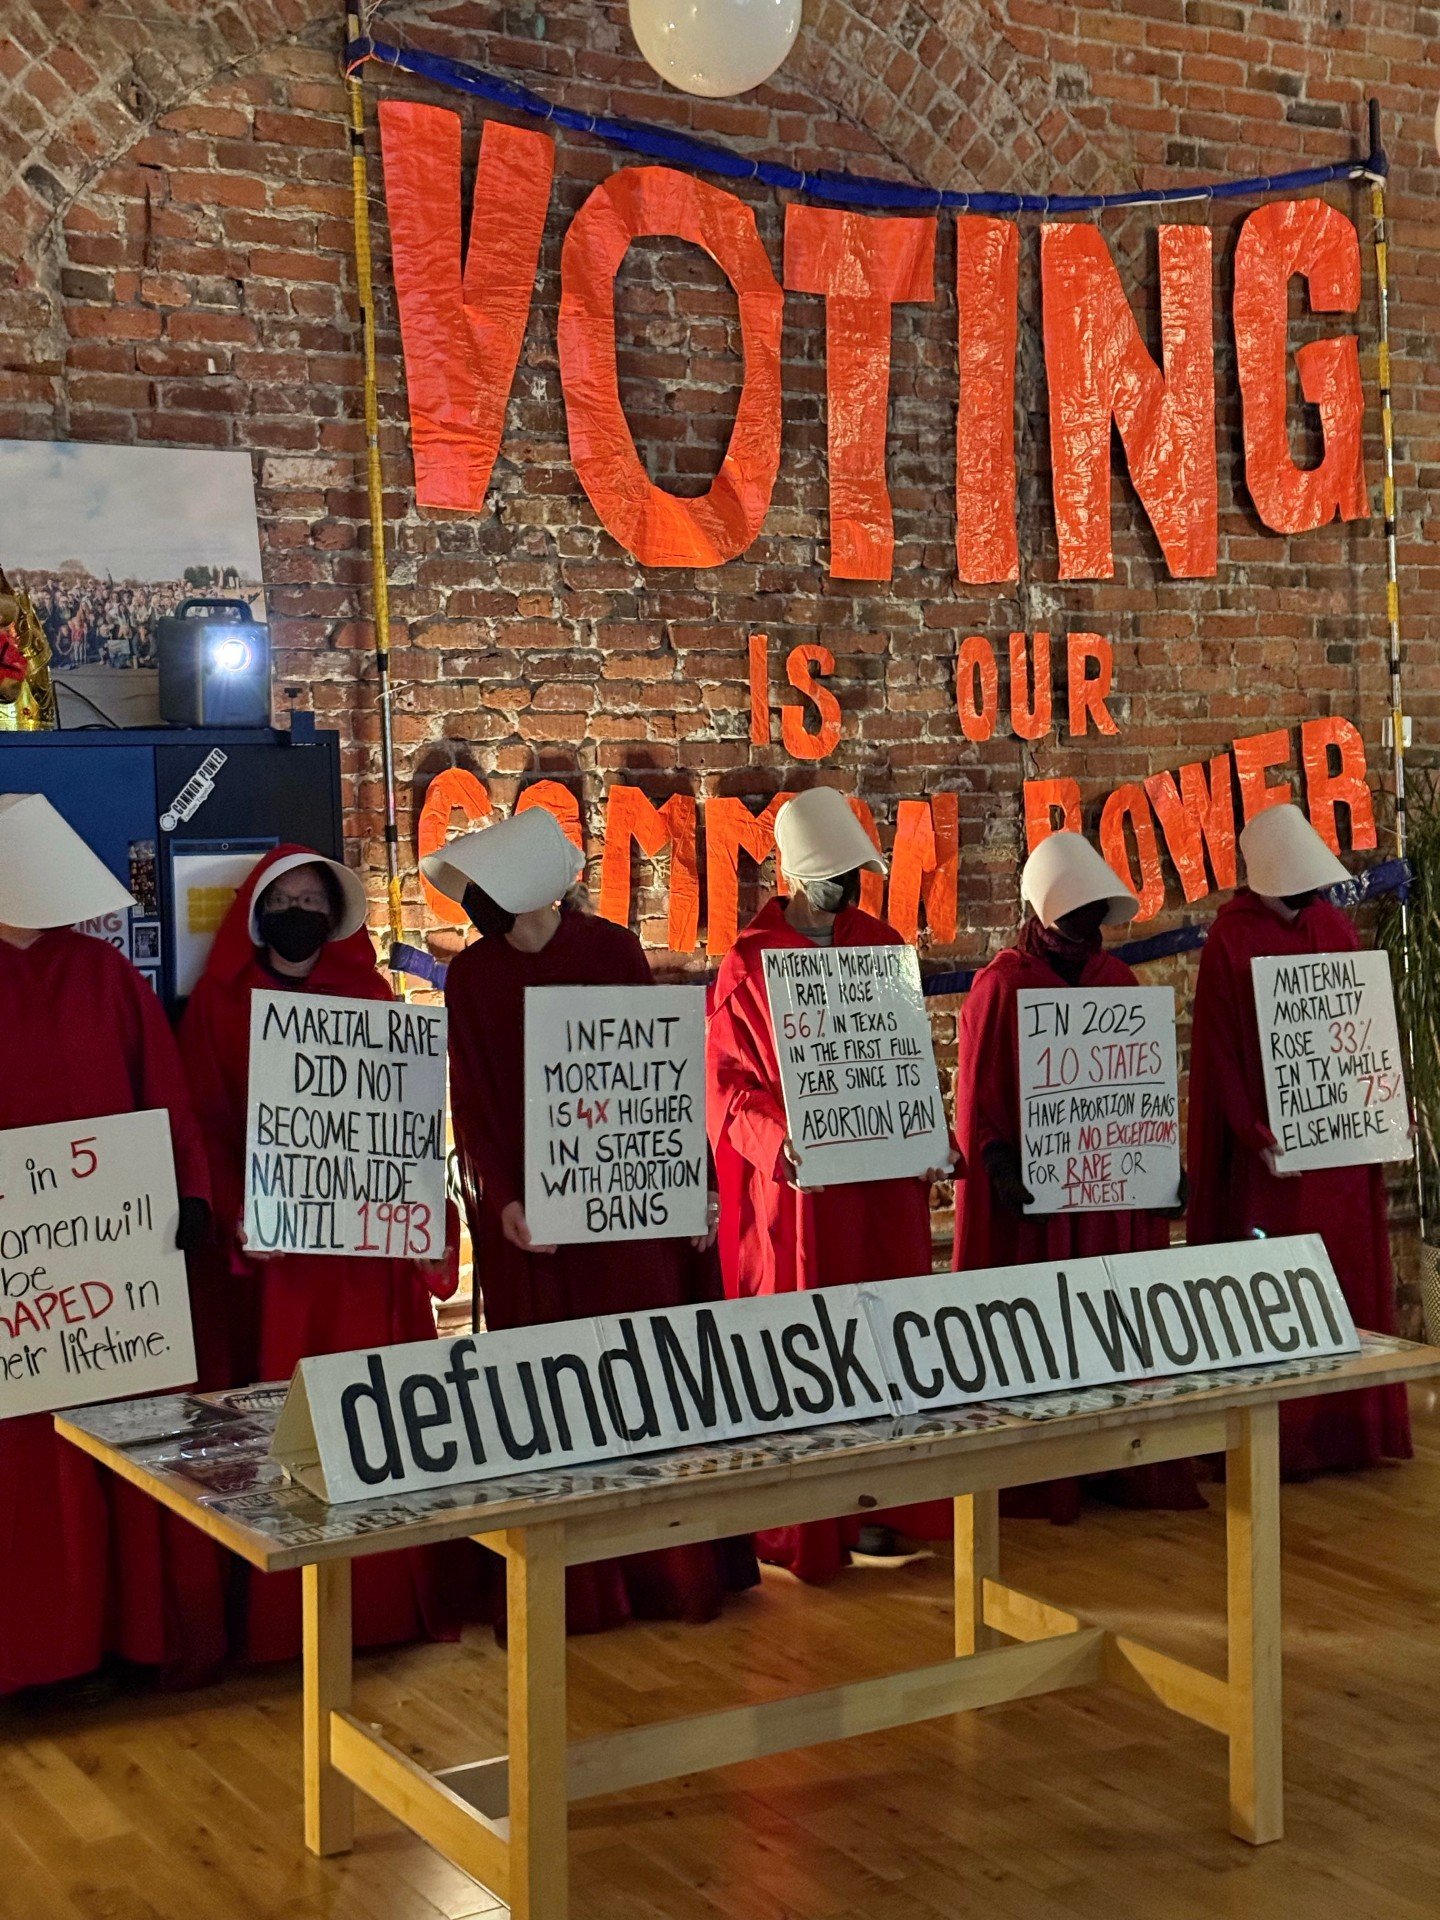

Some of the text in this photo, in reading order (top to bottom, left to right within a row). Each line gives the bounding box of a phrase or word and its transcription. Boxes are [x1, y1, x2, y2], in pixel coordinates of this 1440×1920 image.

[377, 100, 1370, 584] VOTING
[747, 632, 1120, 760] IS OUR
[172, 749, 226, 815] COMMON POWER
[767, 952, 833, 978] MATERNAL
[1273, 959, 1365, 997] MATERNAL
[796, 980, 873, 1006] RATE ROSE
[1273, 991, 1362, 1026] MORTALITY
[263, 1002, 441, 1056] MARITAL RAPE
[567, 1017, 680, 1052] INFANT
[783, 1009, 898, 1040] 56% IN TEXAS
[1024, 1001, 1146, 1037] IN 2025
[790, 1037, 922, 1064] IN THE FIRST FULL
[1271, 1018, 1372, 1060] ROSE 33%
[295, 1052, 408, 1102] DID NOT
[544, 1058, 688, 1093] MORTALITY
[797, 1063, 920, 1095] YEAR SINCE ITS
[1033, 1041, 1162, 1089] 10 STATES
[1275, 1050, 1392, 1089] IN TX WHILE
[549, 1094, 693, 1129] IS 4X HIGHER
[802, 1096, 935, 1141] ABORTION BAN
[1028, 1093, 1175, 1128] HAVE ABORTION BANS
[1280, 1083, 1348, 1117] FALLING
[258, 1102, 446, 1160] BECOME ILLEGAL
[550, 1129, 683, 1166] IN STATES
[1025, 1120, 1177, 1158] WITH NO EXCEPTIONS
[1282, 1110, 1389, 1152] ELSEWHERE
[25, 1136, 98, 1194] in 5
[252, 1152, 418, 1204] NATIONWIDE
[541, 1157, 701, 1197] WITH ABORTION
[1028, 1151, 1147, 1185] FOR RAPE OR
[0, 1194, 152, 1259] omen will
[254, 1200, 432, 1256] UNTIL 1993
[586, 1192, 668, 1233] BANS
[0, 1266, 54, 1297] be
[126, 1281, 159, 1310] in
[60, 1327, 170, 1375] lifetime.
[340, 1265, 1344, 1485] defundMusk.com/women
